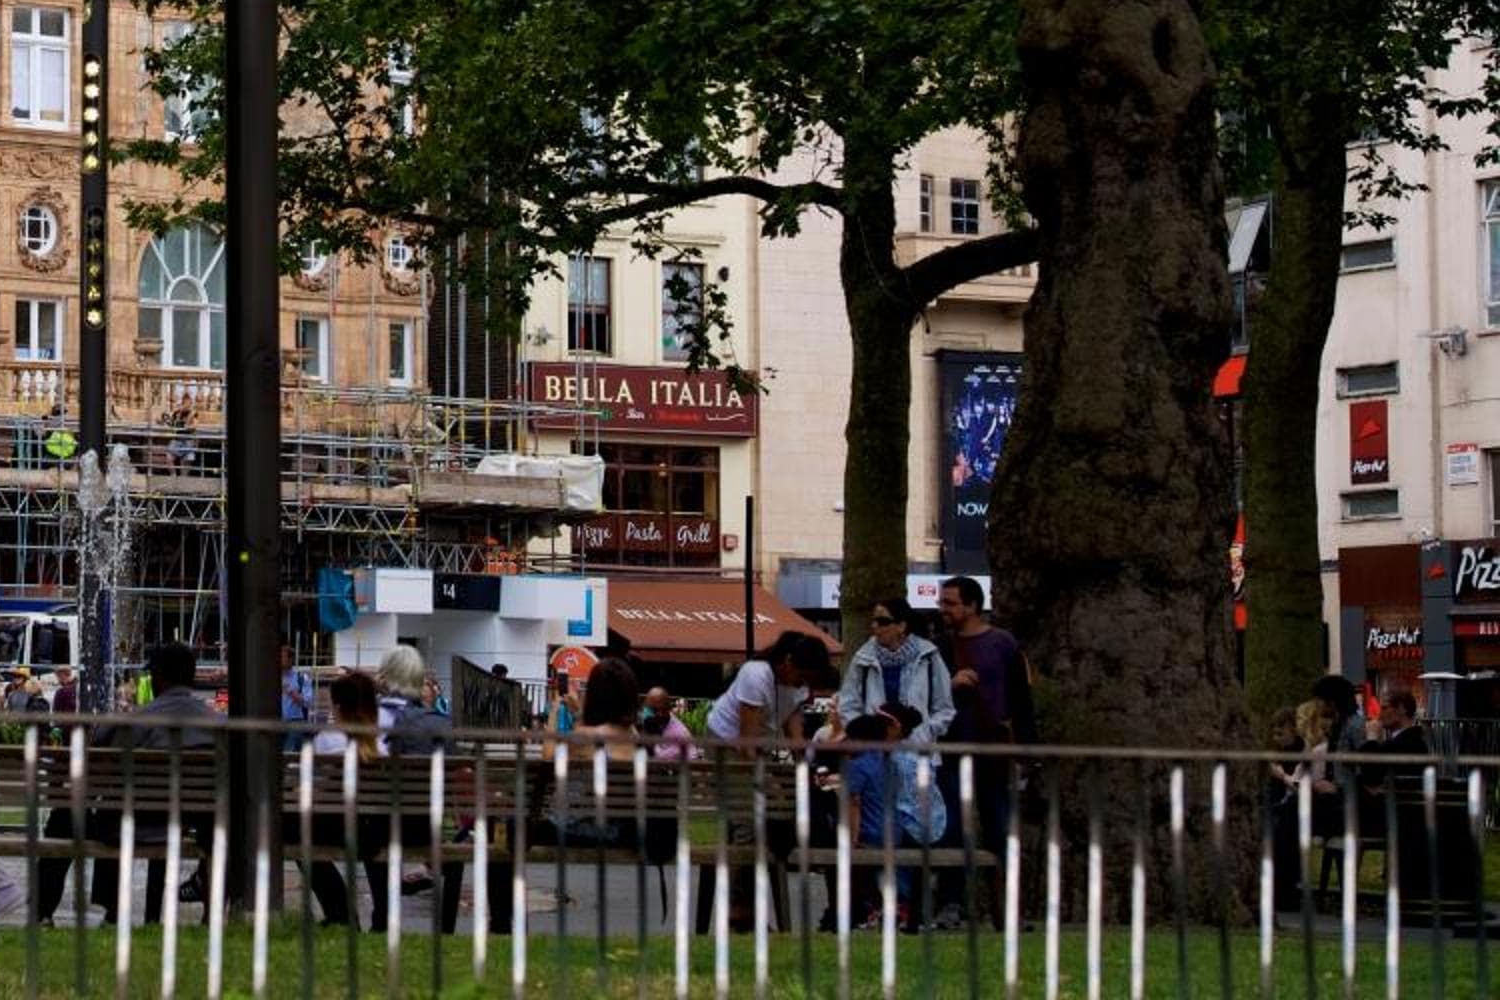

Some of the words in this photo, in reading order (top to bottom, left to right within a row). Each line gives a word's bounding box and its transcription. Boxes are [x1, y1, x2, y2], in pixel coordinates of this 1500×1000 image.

[545, 375, 634, 404] BELLA
[651, 380, 744, 408] ITALIA
[957, 503, 989, 516] NOW
[625, 521, 662, 541] Pasta
[677, 522, 711, 547] Grill
[615, 609, 691, 622] BELLA
[692, 611, 775, 623] ITALA
